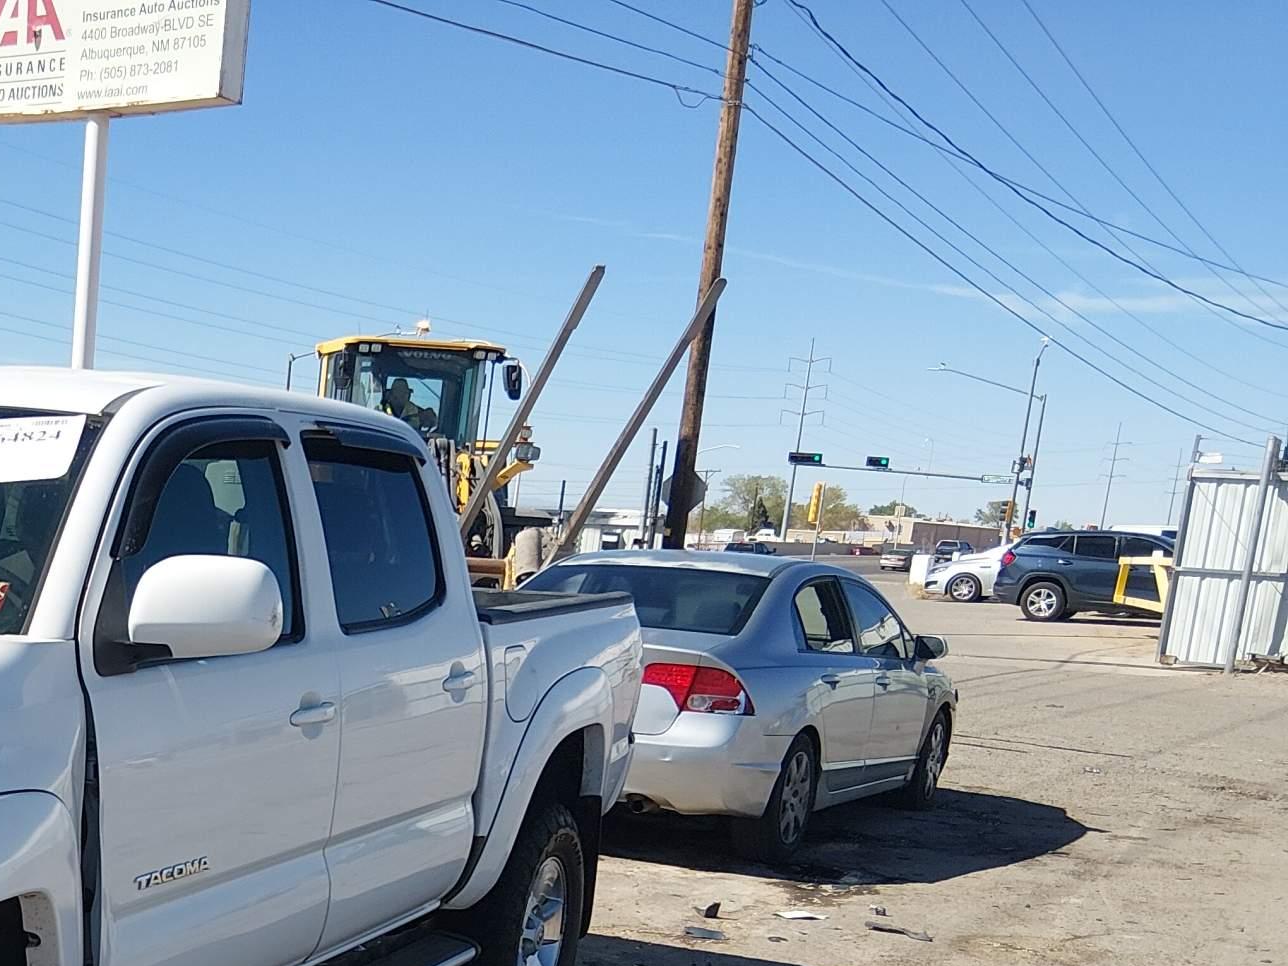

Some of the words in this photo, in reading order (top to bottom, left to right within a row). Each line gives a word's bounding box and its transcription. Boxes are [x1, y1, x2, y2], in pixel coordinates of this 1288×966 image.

[82, 7, 136, 23] Insurance
[139, 3, 165, 16] Auto
[167, 0, 220, 12] Auctions
[81, 27, 107, 41] 4400
[198, 13, 215, 28] SE
[80, 44, 148, 61] Albuquerque,
[151, 38, 170, 54] NM
[173, 34, 207, 50] 87105
[79, 69, 97, 82] Ph:
[99, 65, 127, 82] (505)
[129, 60, 179, 78] 873-2081
[7, 83, 64, 101] AUCTIONS
[77, 84, 148, 100] www.iaai.com
[397, 351, 452, 360] VOLVO
[133, 856, 210, 890] TACOMA
